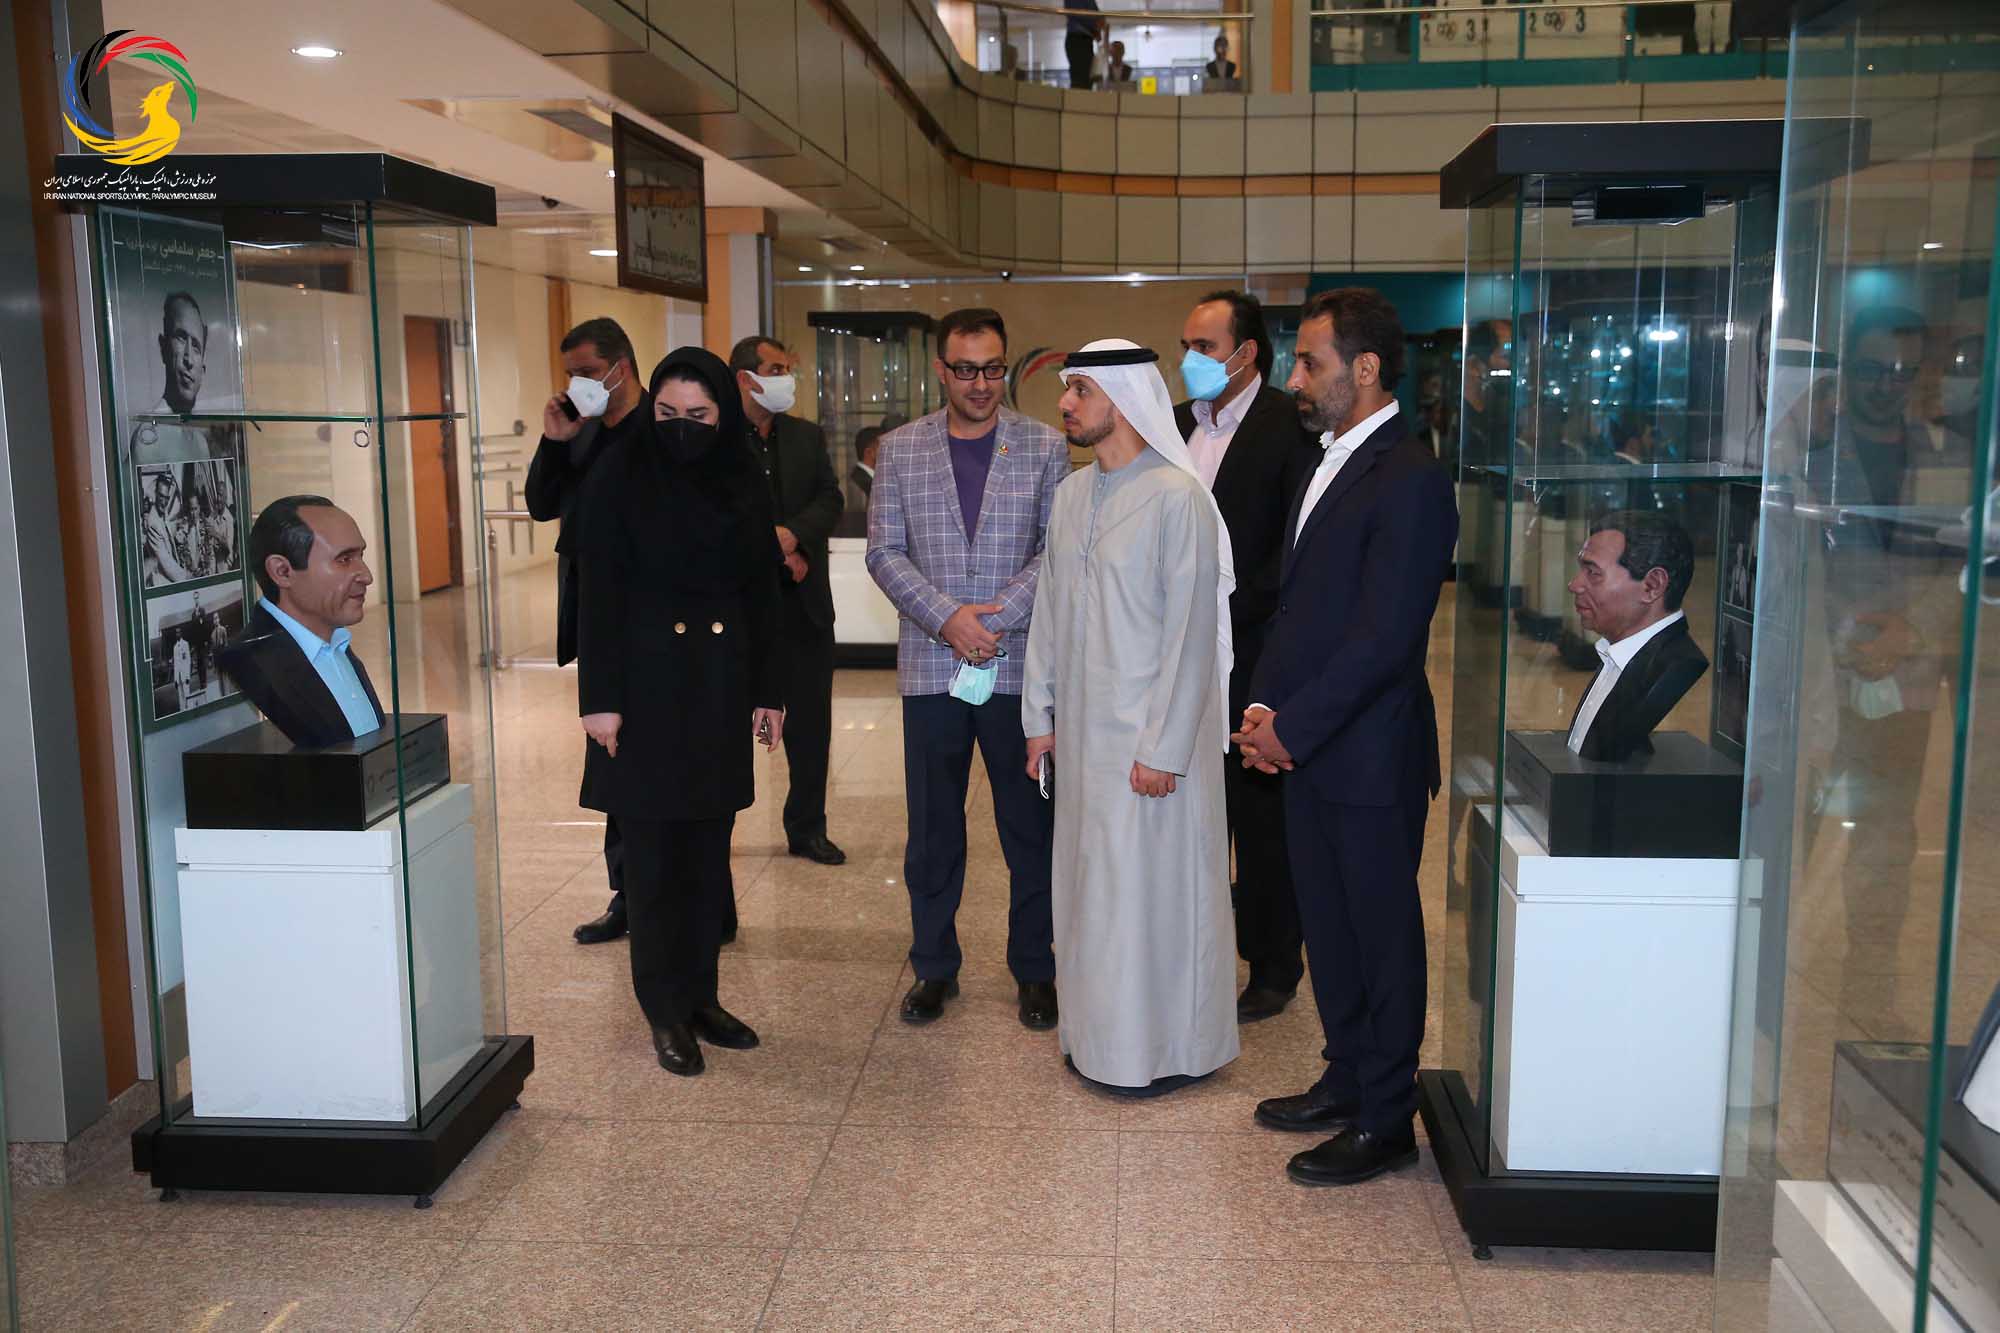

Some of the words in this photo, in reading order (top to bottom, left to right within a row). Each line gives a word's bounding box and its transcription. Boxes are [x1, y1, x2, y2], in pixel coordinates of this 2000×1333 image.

[1466, 18, 1476, 42] 3
[1528, 11, 1537, 33] 2
[1575, 7, 1586, 33] 3
